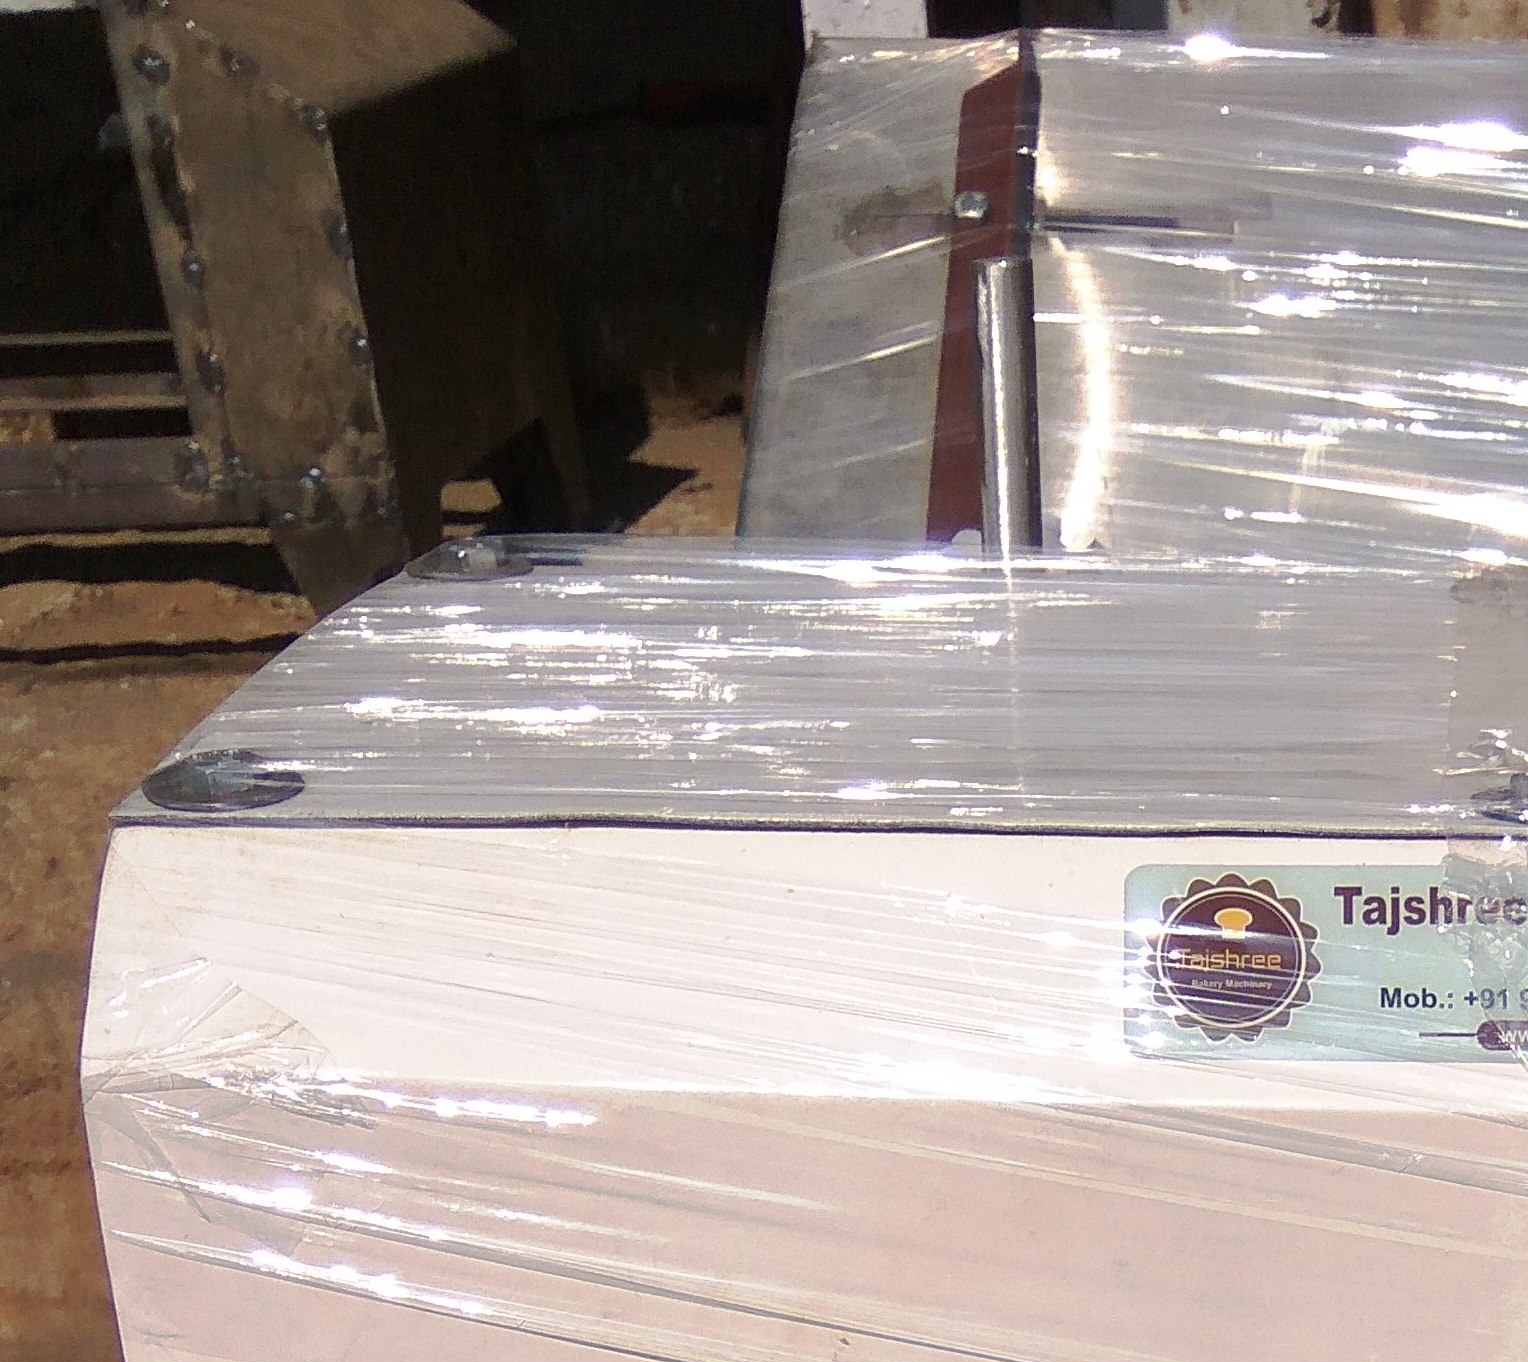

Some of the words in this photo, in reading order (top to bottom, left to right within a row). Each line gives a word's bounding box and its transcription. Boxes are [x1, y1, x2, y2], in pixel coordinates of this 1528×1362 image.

[1334, 886, 1528, 935] Tajshree
[1179, 948, 1282, 971] Tajshree
[1380, 987, 1453, 1009] Mob.:
[1463, 988, 1507, 1010] +91
